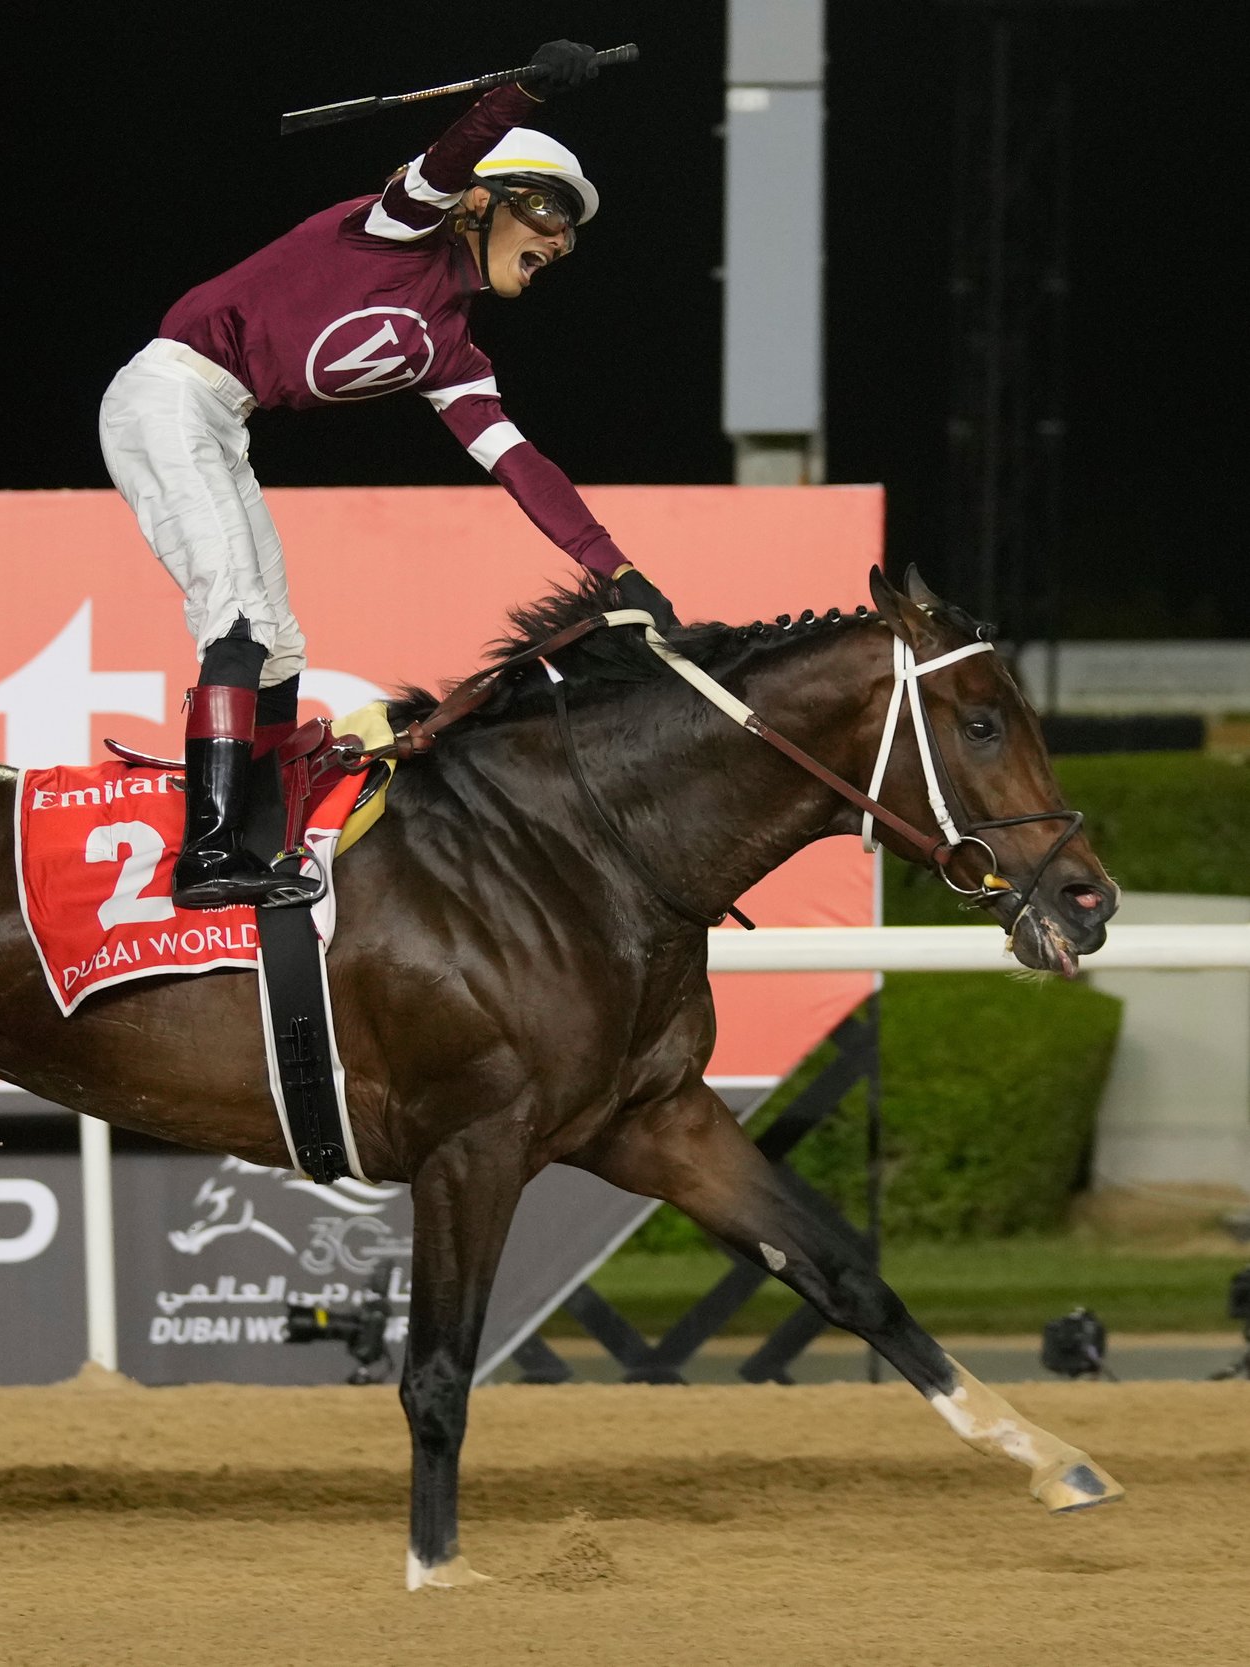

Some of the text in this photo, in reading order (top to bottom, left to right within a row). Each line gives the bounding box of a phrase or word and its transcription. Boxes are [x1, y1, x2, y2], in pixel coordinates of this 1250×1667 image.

[324, 321, 415, 392] W
[32, 772, 186, 810] Emirat
[85, 820, 176, 931] 2
[62, 940, 141, 992] DUBAI
[150, 1317, 241, 1344] DUBAI
